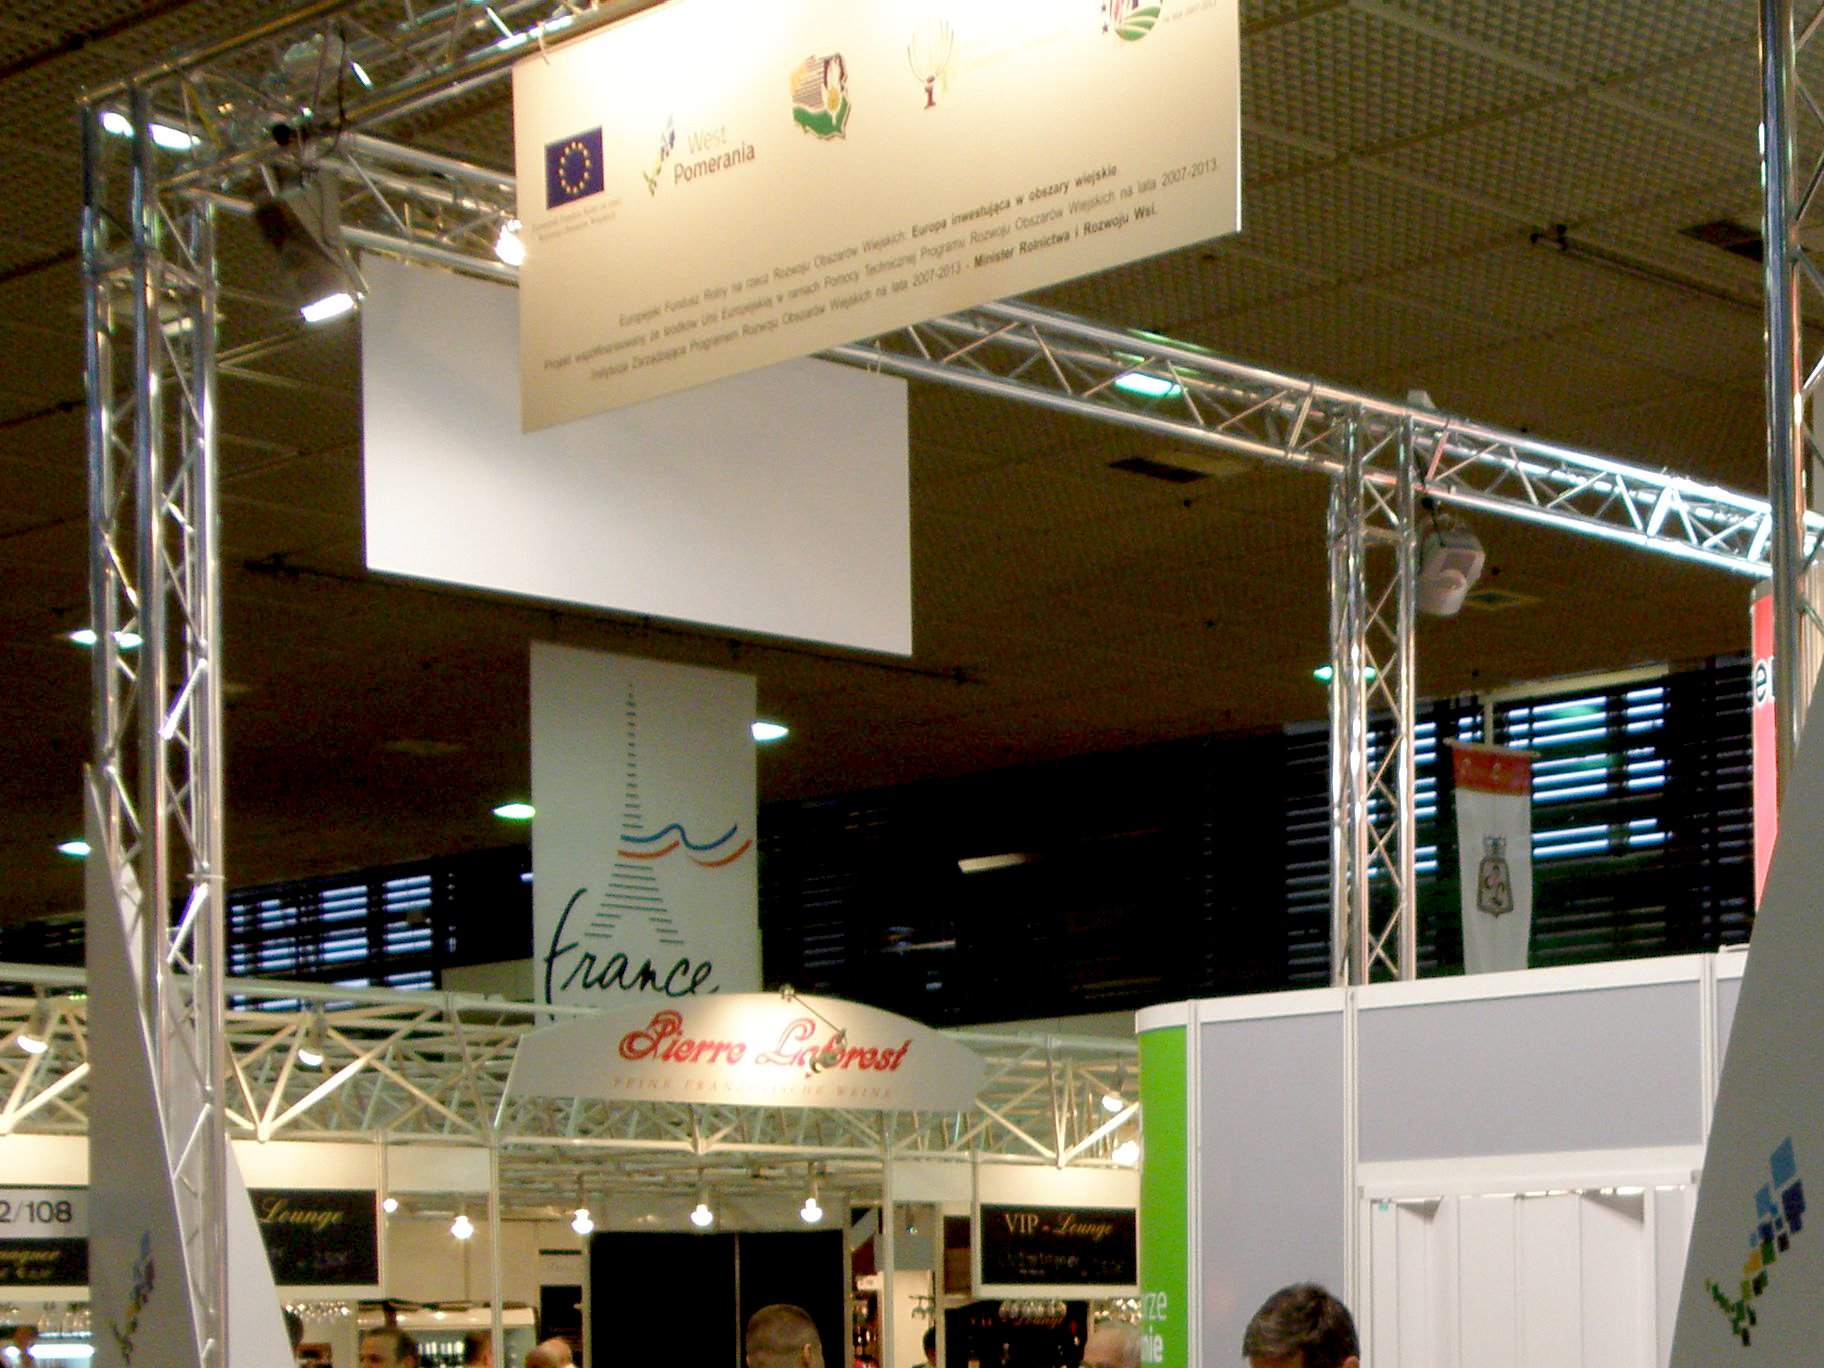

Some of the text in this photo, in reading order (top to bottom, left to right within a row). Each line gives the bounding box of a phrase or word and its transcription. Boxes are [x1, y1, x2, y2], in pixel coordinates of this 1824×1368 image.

[687, 124, 726, 154] West
[674, 140, 755, 185] Pomerania
[911, 217, 947, 239] Europa
[1028, 179, 1070, 203] obszary
[1074, 163, 1118, 187] wiejskie
[1119, 185, 1133, 198] na
[973, 248, 1014, 269] Minister
[1019, 229, 1071, 254] Rolnictwa
[1082, 211, 1130, 236] Rozwoju
[617, 1008, 747, 1065] Pierre
[1004, 1212, 1039, 1233] VIP
[1053, 1210, 1115, 1242] Lounge
